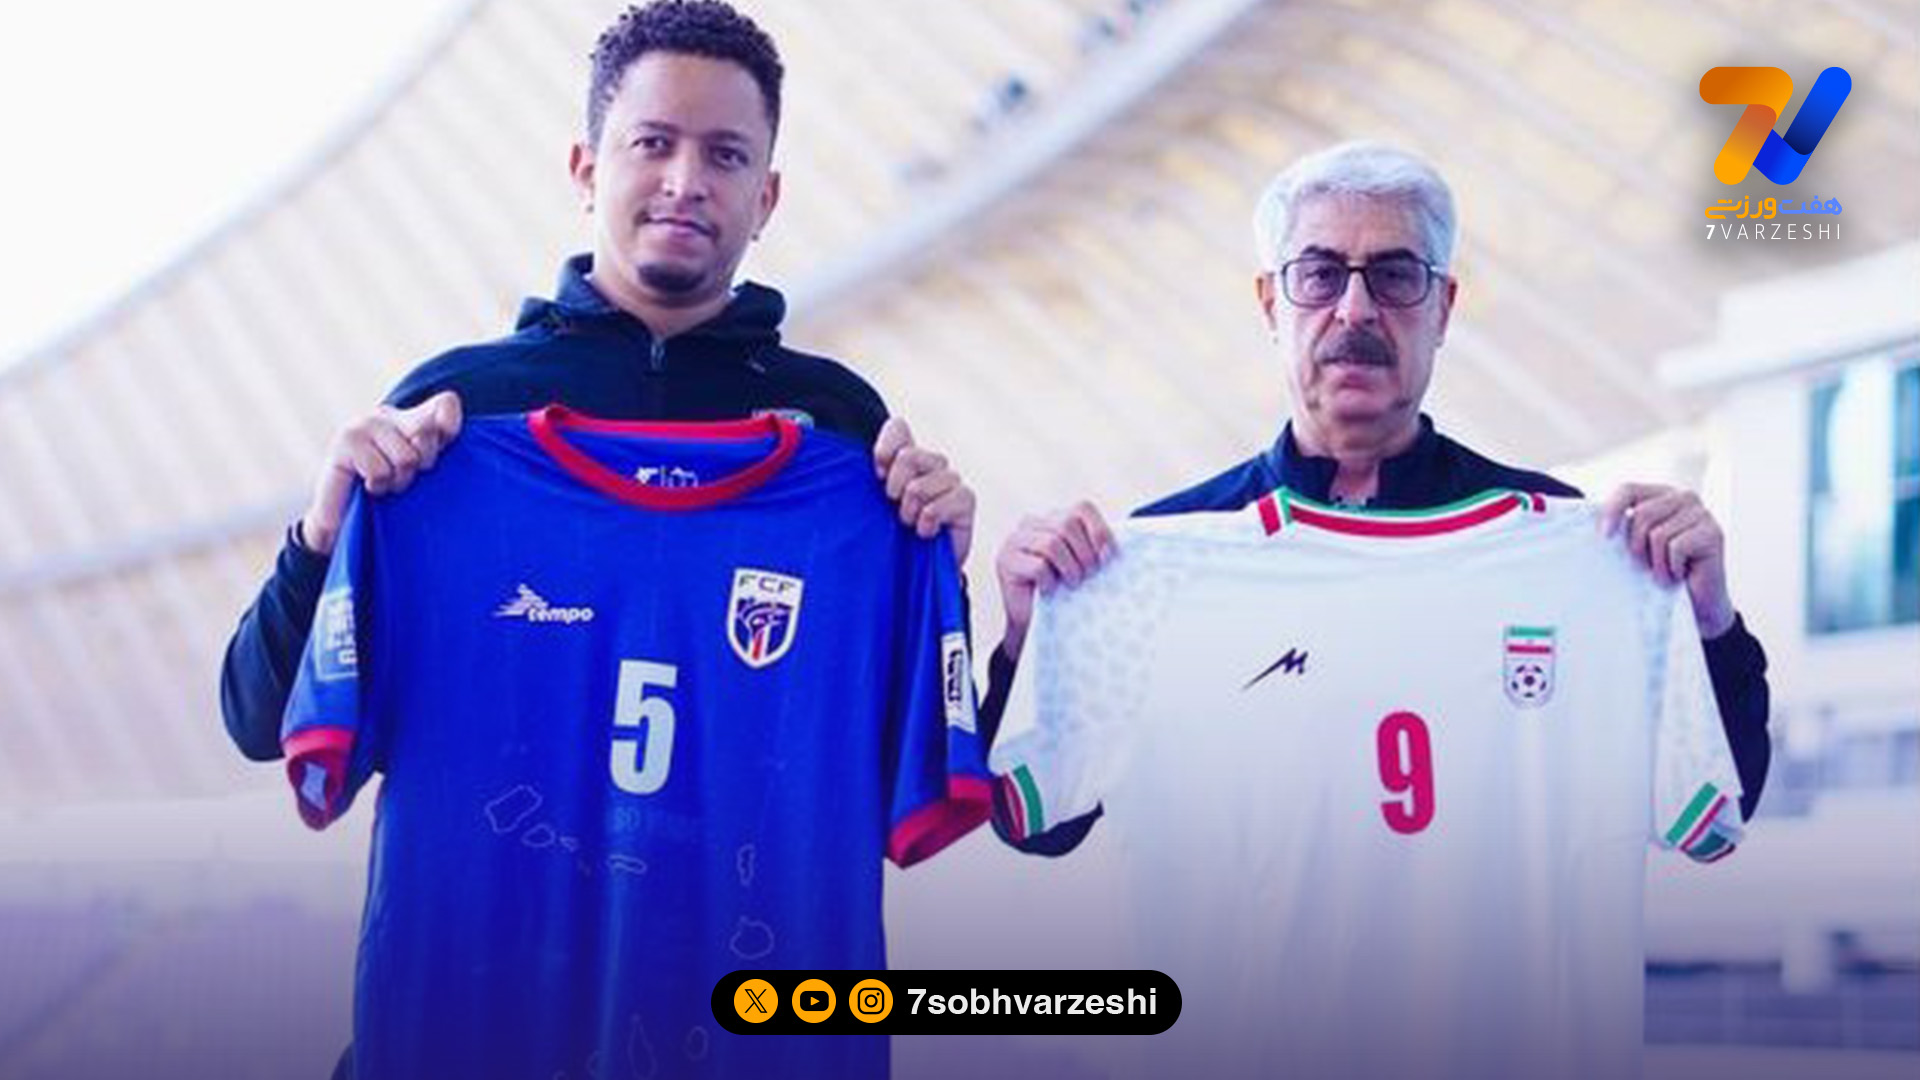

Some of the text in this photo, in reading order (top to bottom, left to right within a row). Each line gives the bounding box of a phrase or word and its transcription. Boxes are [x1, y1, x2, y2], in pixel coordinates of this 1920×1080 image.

[527, 606, 595, 625] tempo
[738, 573, 796, 593] FCF
[609, 658, 678, 796] 5
[1376, 711, 1436, 835] 9
